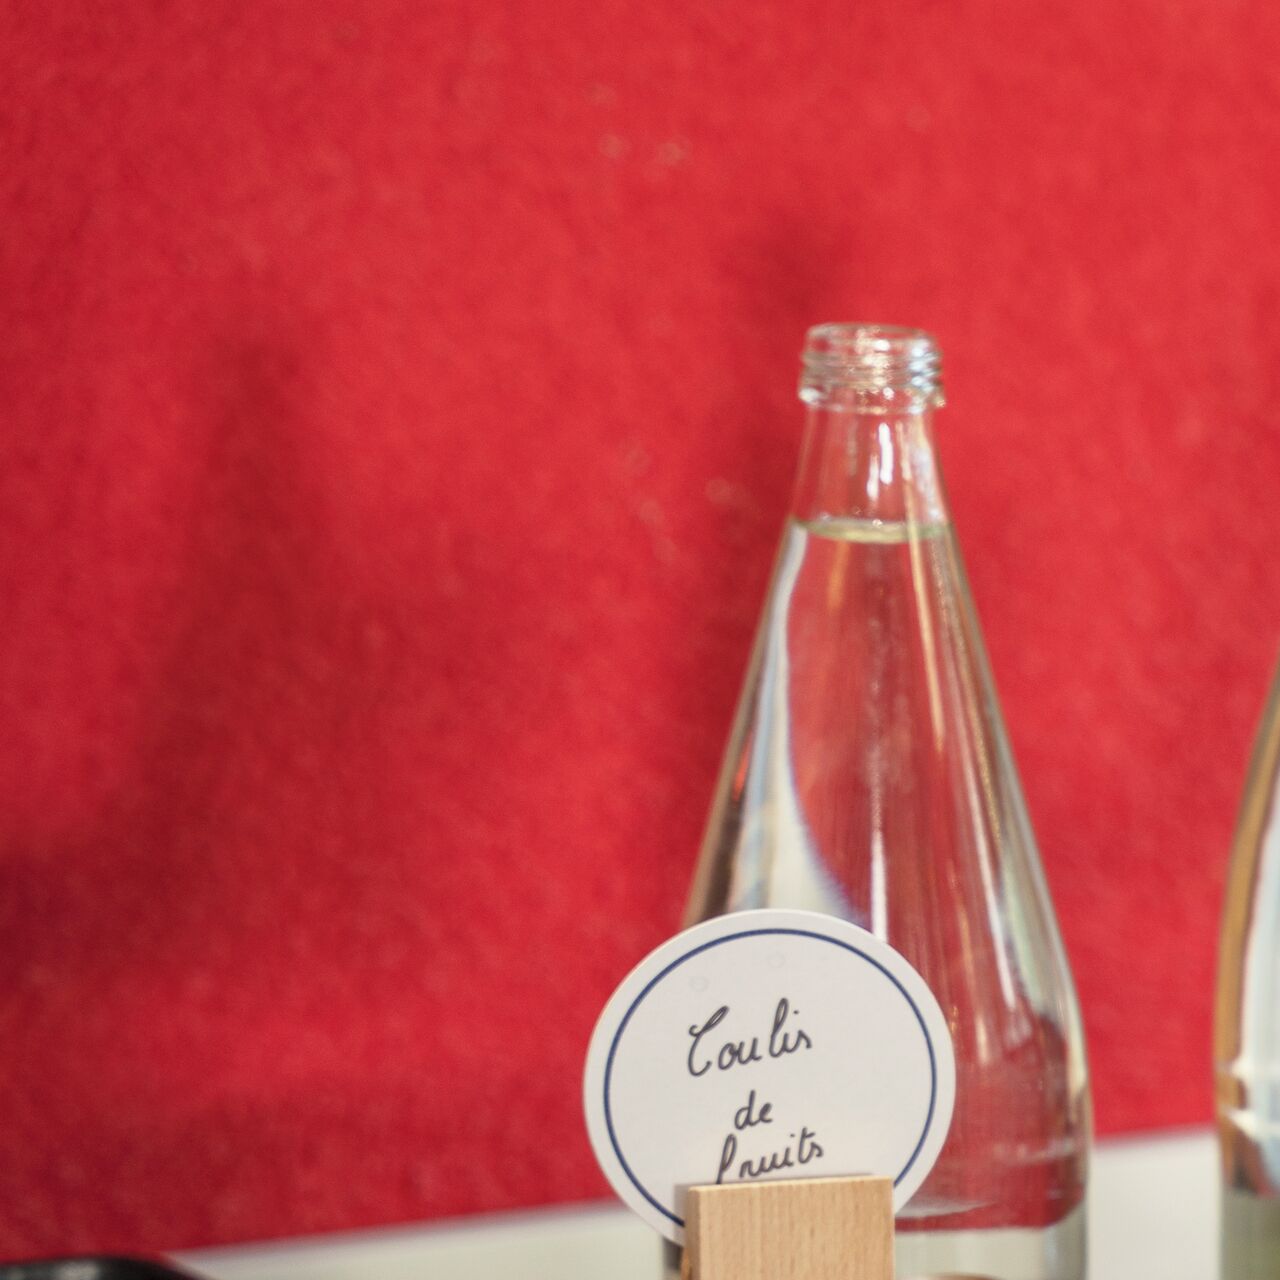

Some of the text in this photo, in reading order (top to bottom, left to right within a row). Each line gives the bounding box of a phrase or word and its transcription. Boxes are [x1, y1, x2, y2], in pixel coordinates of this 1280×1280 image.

[687, 997, 813, 1078] Coulis
[733, 1089, 774, 1131] de
[714, 1127, 824, 1185] fruits
